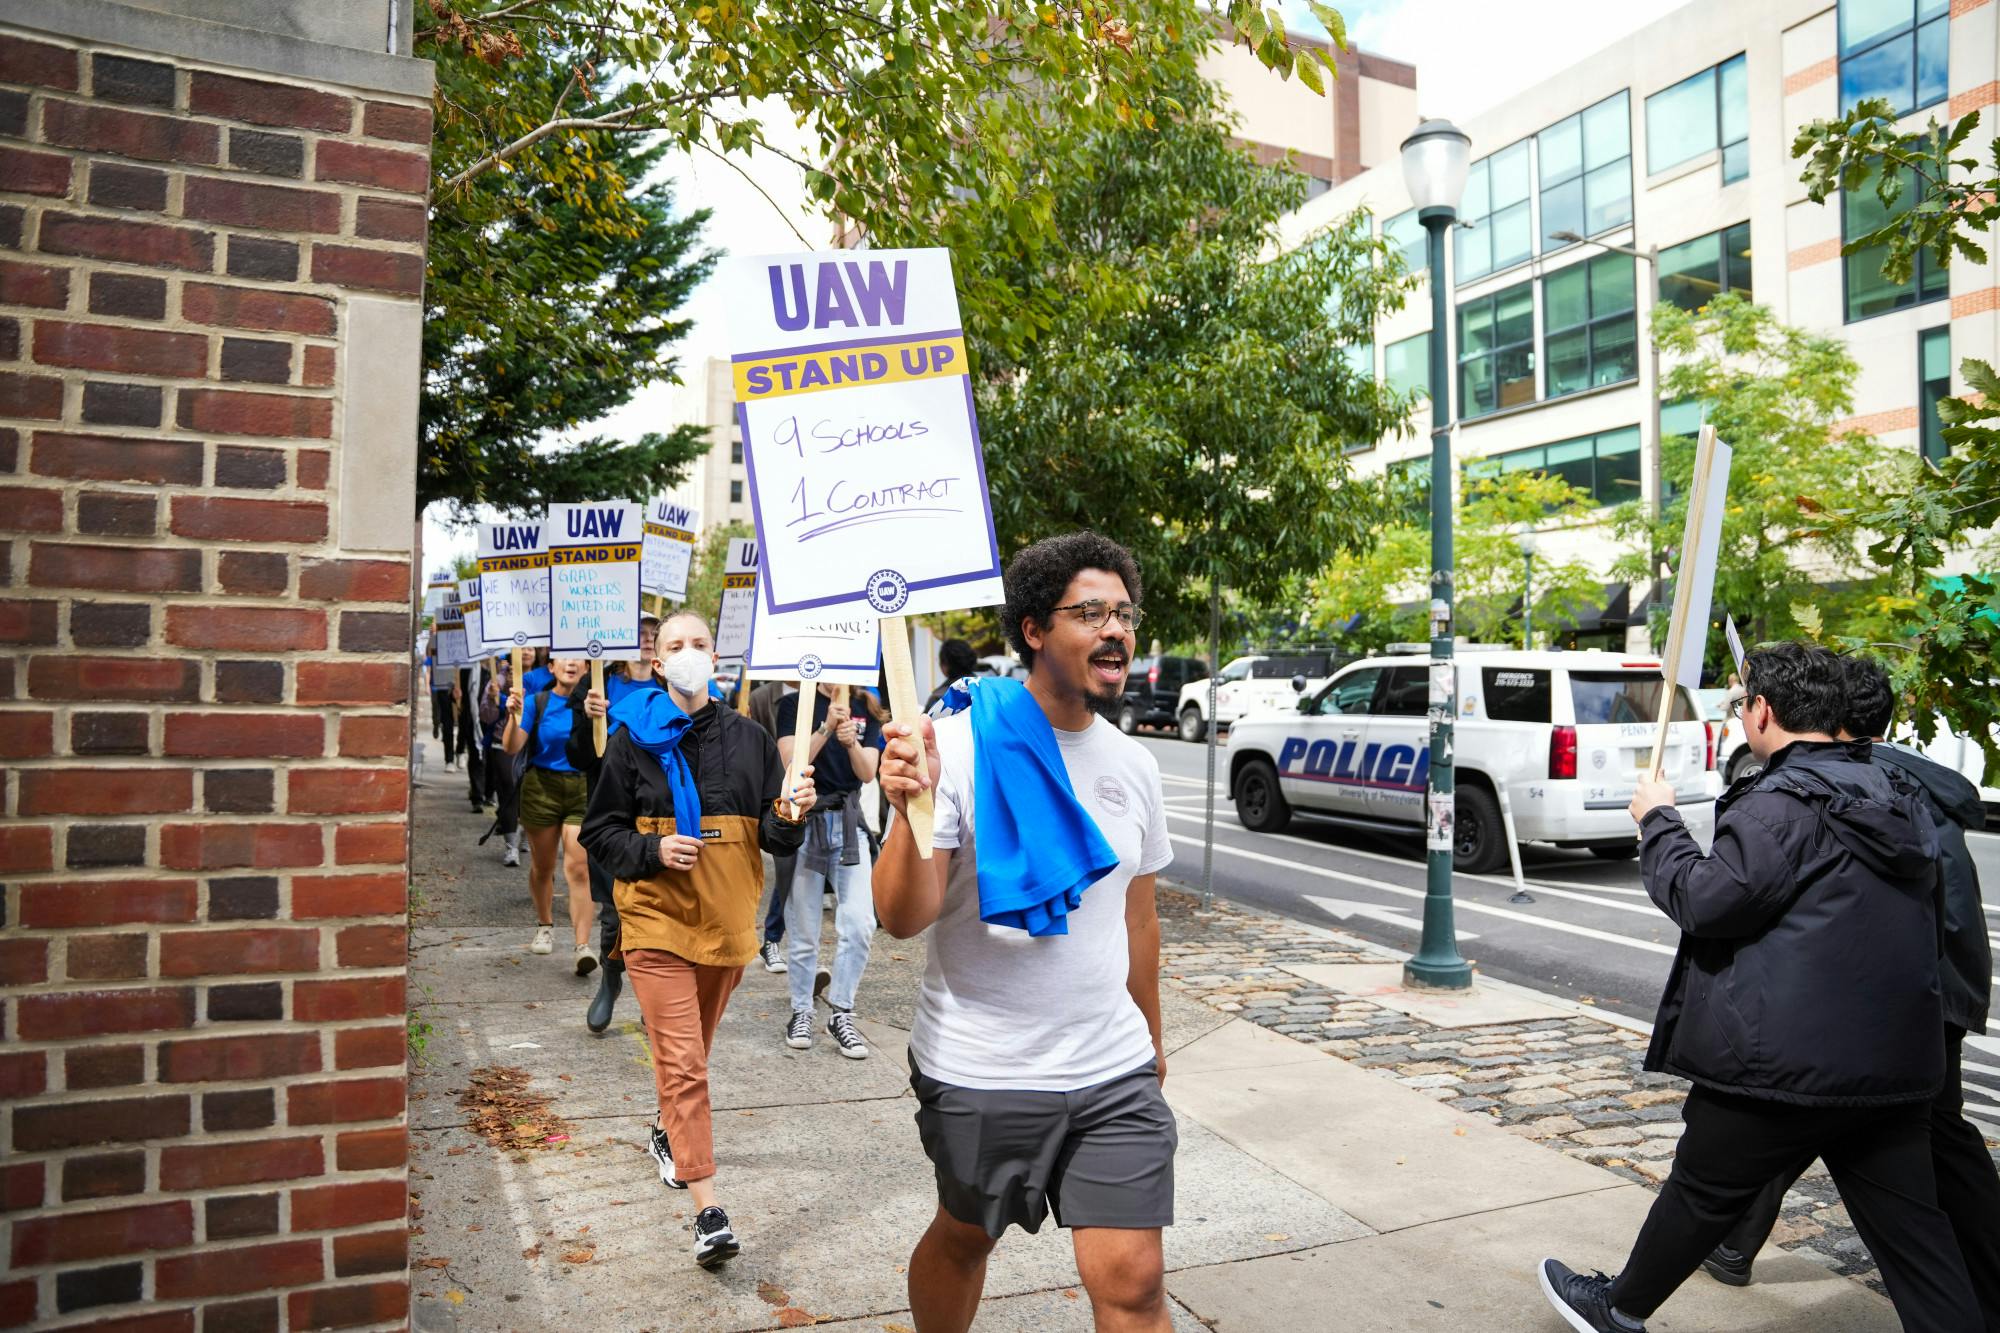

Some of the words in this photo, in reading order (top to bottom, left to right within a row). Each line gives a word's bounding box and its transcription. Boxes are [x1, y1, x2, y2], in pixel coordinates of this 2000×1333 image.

[768, 260, 909, 333] UAW
[746, 352, 889, 395] STAND
[901, 345, 955, 376] UP
[773, 415, 804, 458] 9
[785, 476, 825, 528] 1
[826, 477, 961, 514] CONTRACT
[567, 508, 624, 538] UAW
[657, 502, 690, 528] UAW
[492, 525, 541, 550] UAW
[647, 526, 679, 539] STAND
[681, 533, 693, 542] UP
[553, 550, 610, 564] STAND
[614, 548, 638, 560] UP
[482, 558, 529, 572] STAND
[558, 568, 598, 584] GRAD
[484, 578, 499, 594] WE
[510, 577, 549, 595] MAKE
[568, 582, 622, 596] WORKERS
[486, 602, 520, 617] PENN
[606, 600, 626, 613] FOR
[560, 615, 569, 629] A
[577, 615, 601, 629] FAIR
[586, 629, 636, 640] CONTRACT
